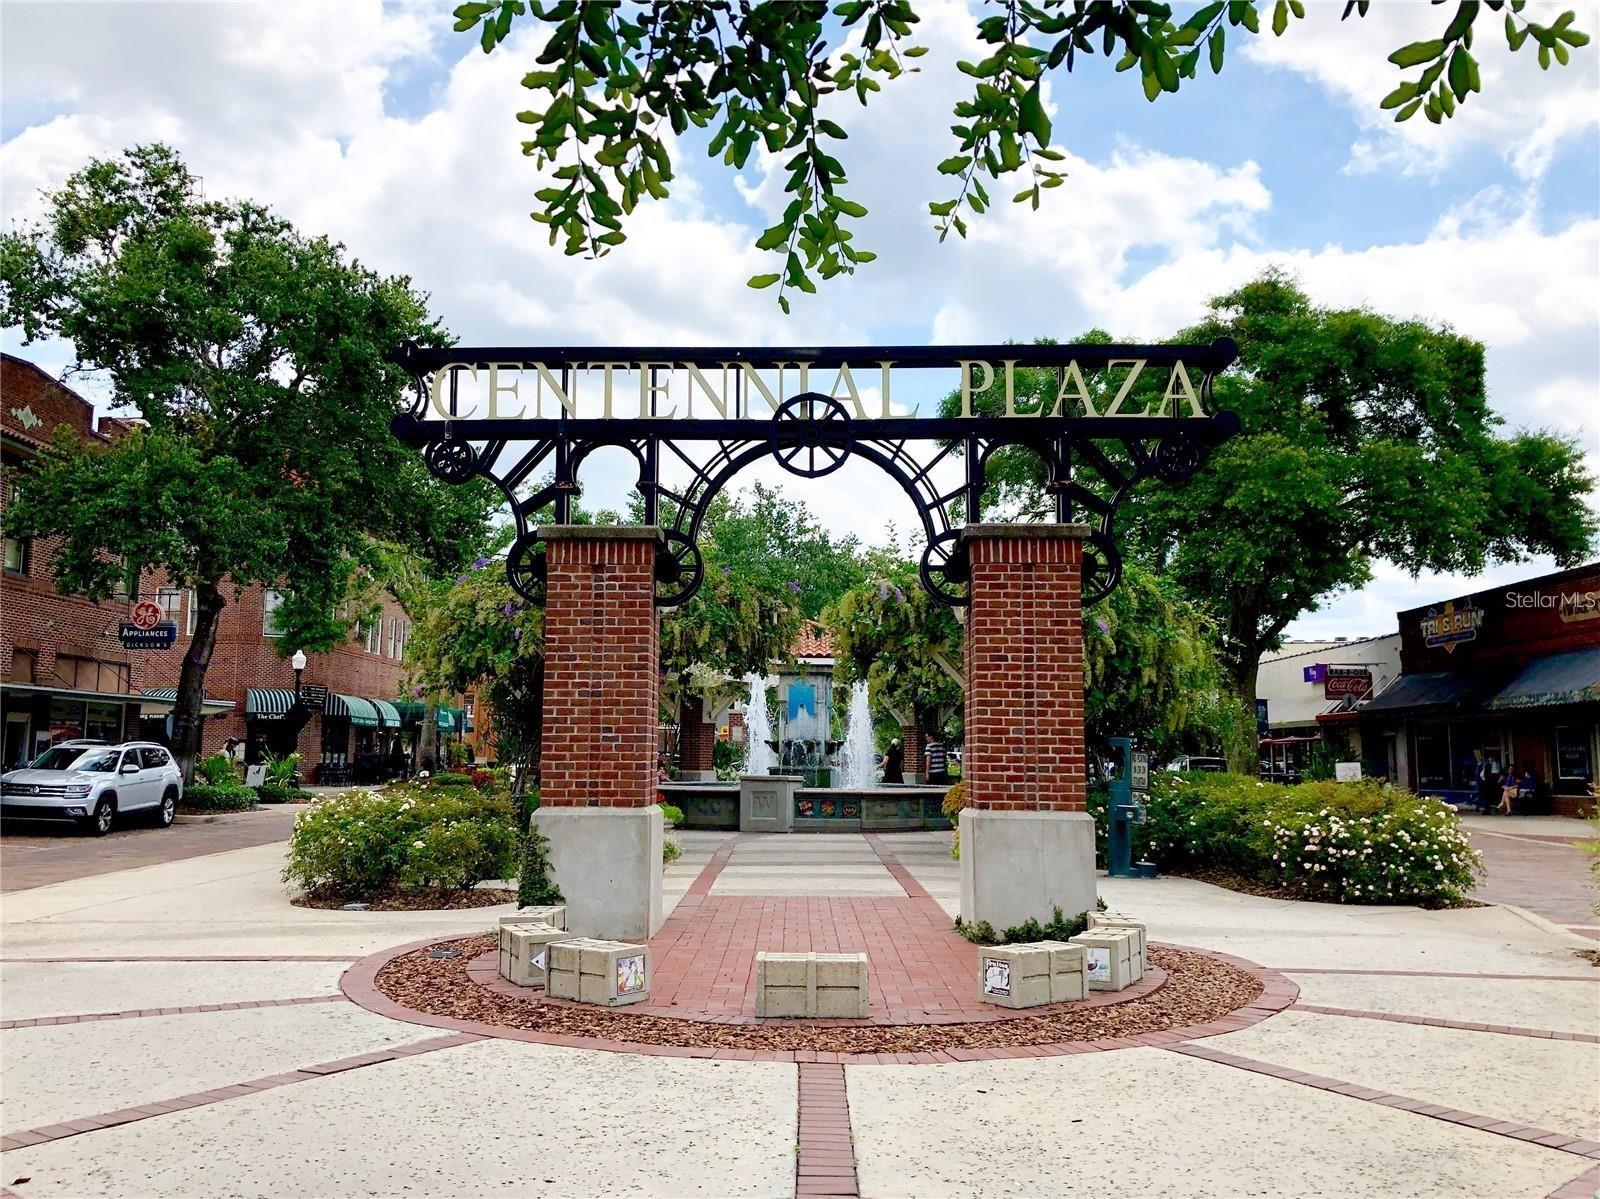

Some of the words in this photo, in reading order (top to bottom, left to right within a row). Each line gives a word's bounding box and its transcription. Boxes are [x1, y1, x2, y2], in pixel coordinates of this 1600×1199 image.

[431, 361, 919, 421] CENTENNIAL
[955, 359, 1210, 418] PLAZA
[122, 628, 168, 637] APPLIANCES
[1420, 620, 1438, 638] TRI
[1442, 617, 1451, 632] &
[1454, 609, 1484, 629] RUN
